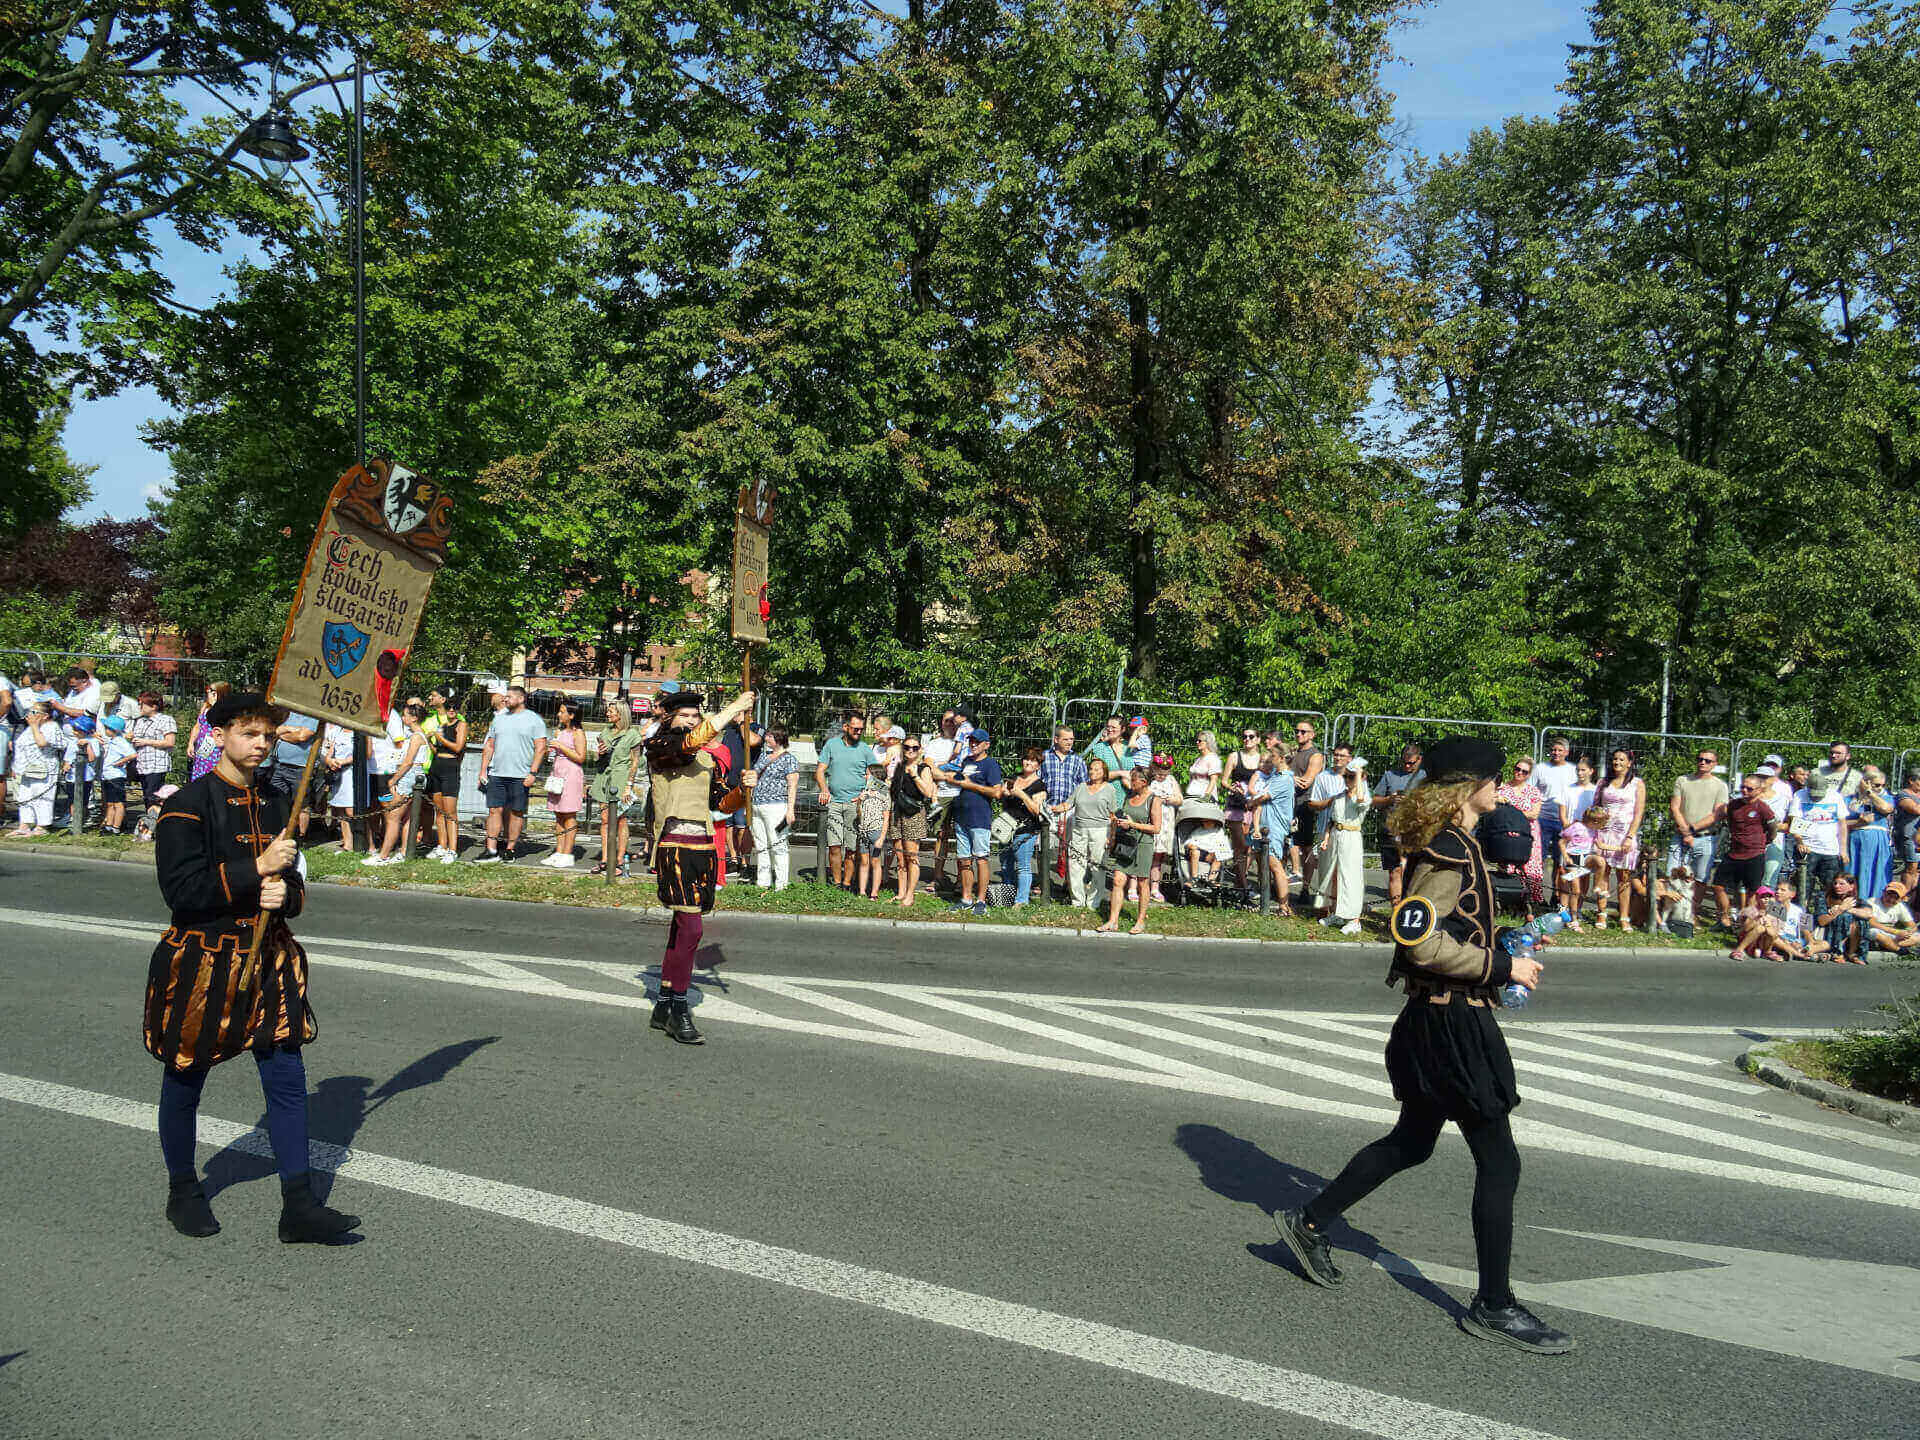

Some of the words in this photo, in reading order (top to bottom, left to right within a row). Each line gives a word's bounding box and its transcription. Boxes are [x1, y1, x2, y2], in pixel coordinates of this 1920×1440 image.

[327, 532, 382, 582] Cech
[321, 563, 408, 615] kowalsko
[321, 683, 363, 716] 1658
[1401, 909, 1423, 928] 12
